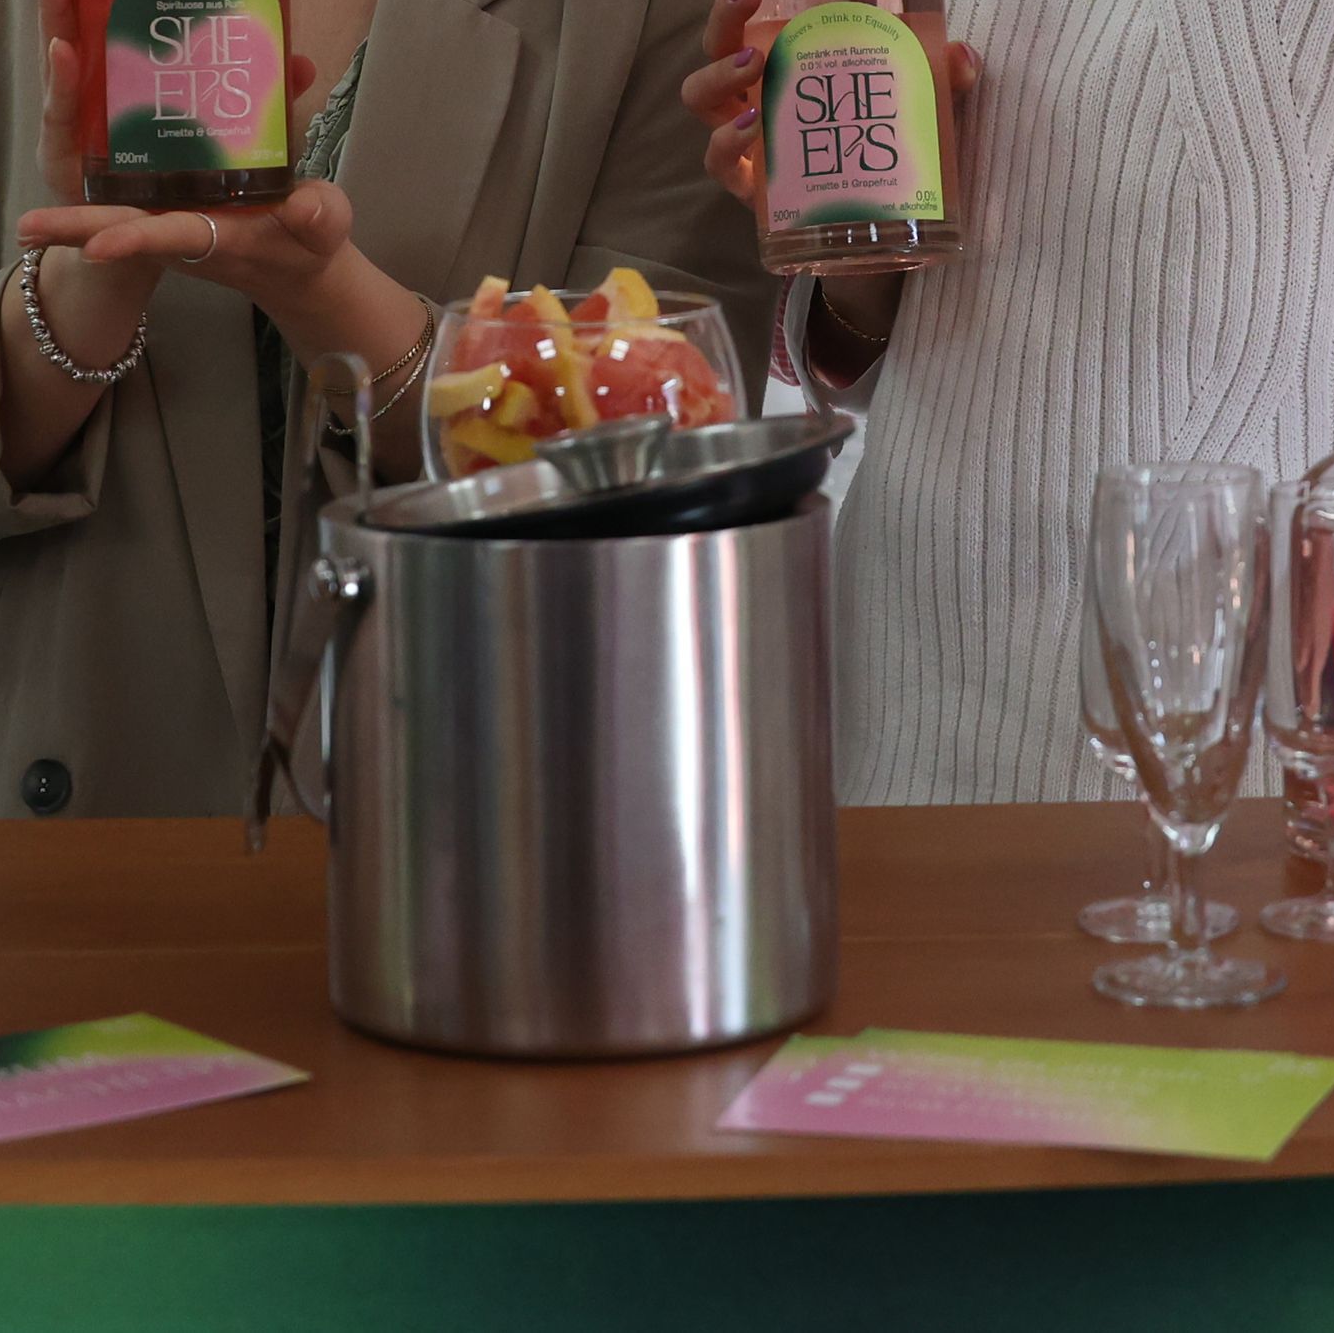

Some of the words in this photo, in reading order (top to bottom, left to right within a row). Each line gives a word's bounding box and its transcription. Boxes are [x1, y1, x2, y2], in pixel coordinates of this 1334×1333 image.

[821, 13, 849, 25] Drink
[852, 14, 862, 23] to
[865, 15, 900, 41] Equality
[149, 15, 251, 67] SHE
[833, 48, 847, 56] mit
[795, 71, 897, 124] SHE
[115, 152, 148, 164] 500ml
[852, 177, 898, 188] Grapefruit
[773, 209, 800, 222] 500ml
